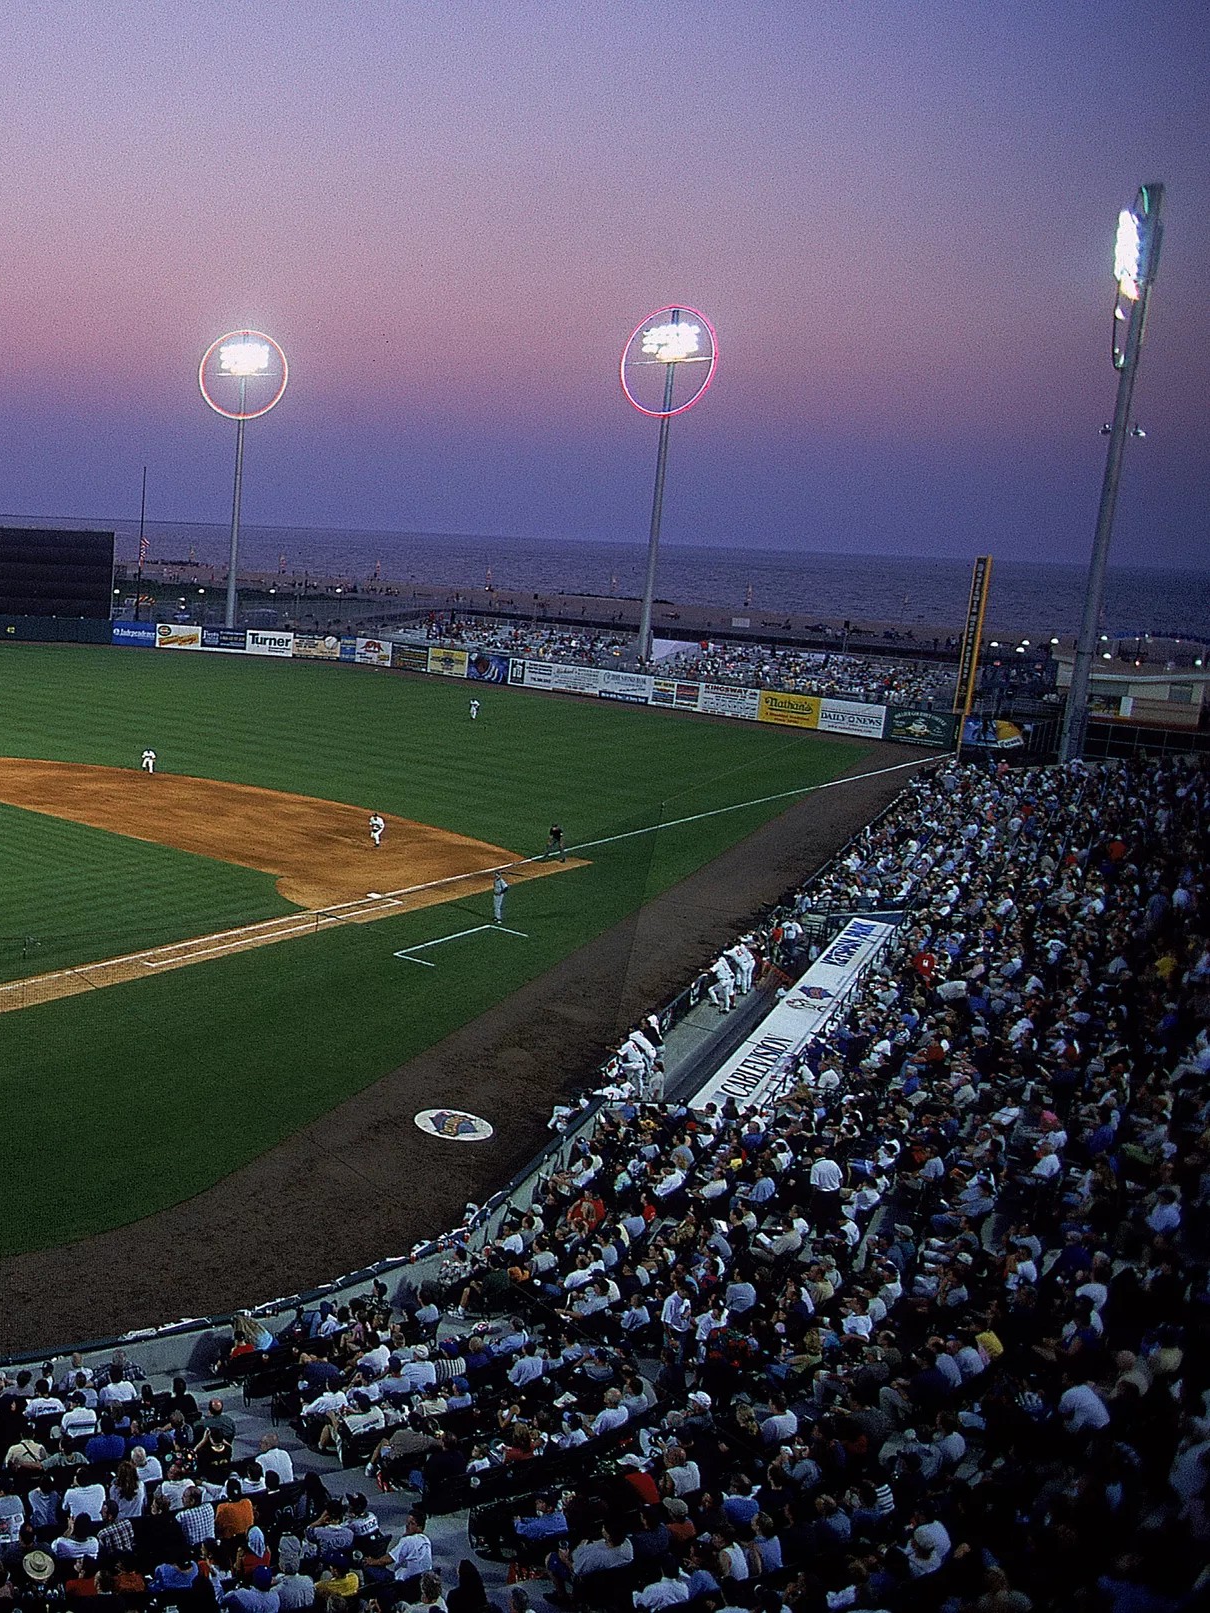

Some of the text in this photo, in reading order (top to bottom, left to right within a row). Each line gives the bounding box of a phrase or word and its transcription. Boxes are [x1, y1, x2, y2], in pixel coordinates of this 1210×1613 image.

[120, 629, 156, 637] Independence
[249, 633, 291, 647] Turner
[704, 685, 749, 694] KINGSWAY
[765, 696, 813, 713] Nathan's
[821, 712, 846, 722] DAILY
[855, 716, 882, 727] NEWS
[720, 1033, 794, 1098] CABLEVISION
